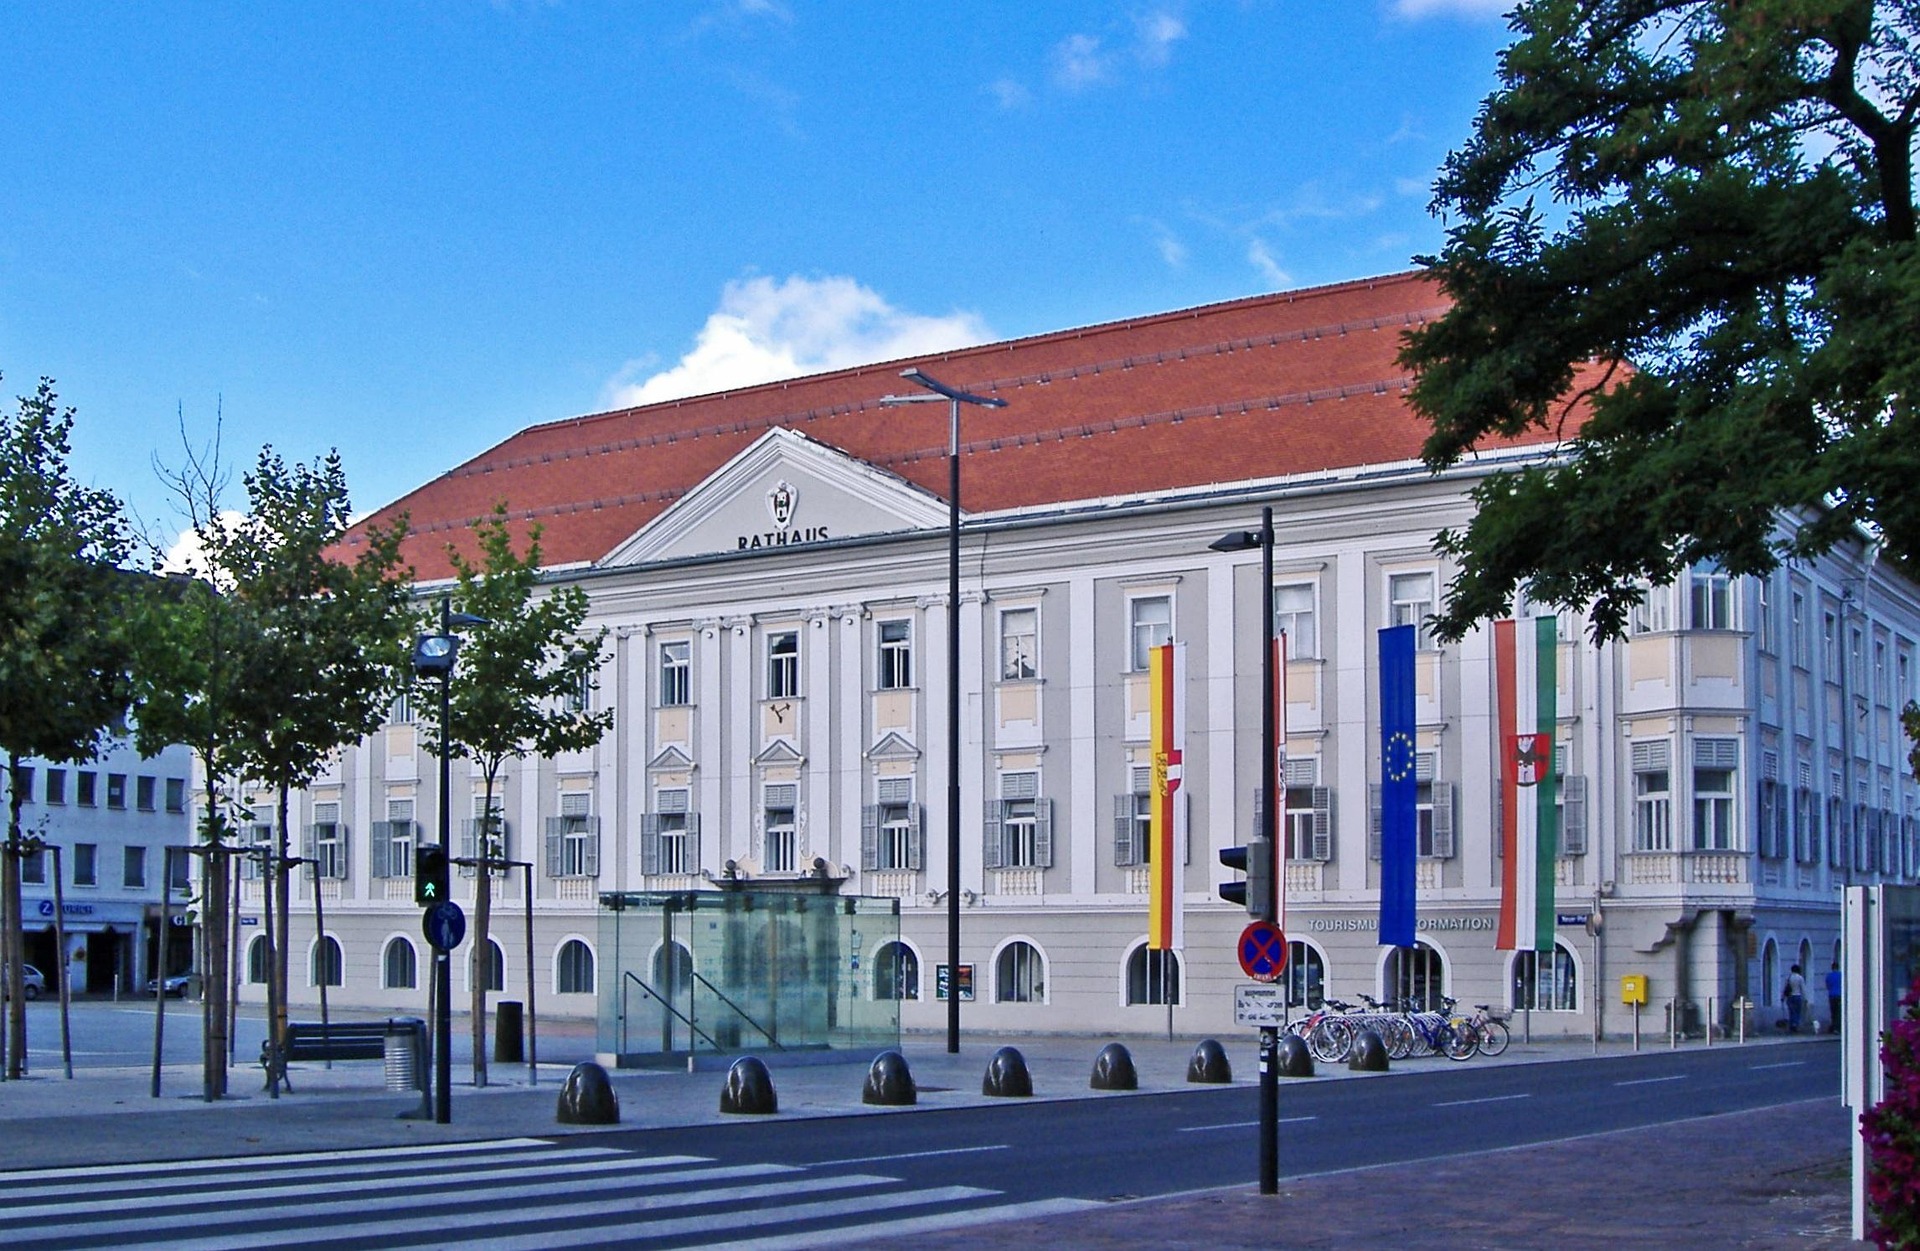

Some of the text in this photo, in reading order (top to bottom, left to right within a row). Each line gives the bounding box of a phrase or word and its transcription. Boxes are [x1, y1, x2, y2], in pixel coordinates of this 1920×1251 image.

[738, 526, 828, 550] RATHAUS
[1308, 917, 1494, 932] TOURISMU ORMATION
